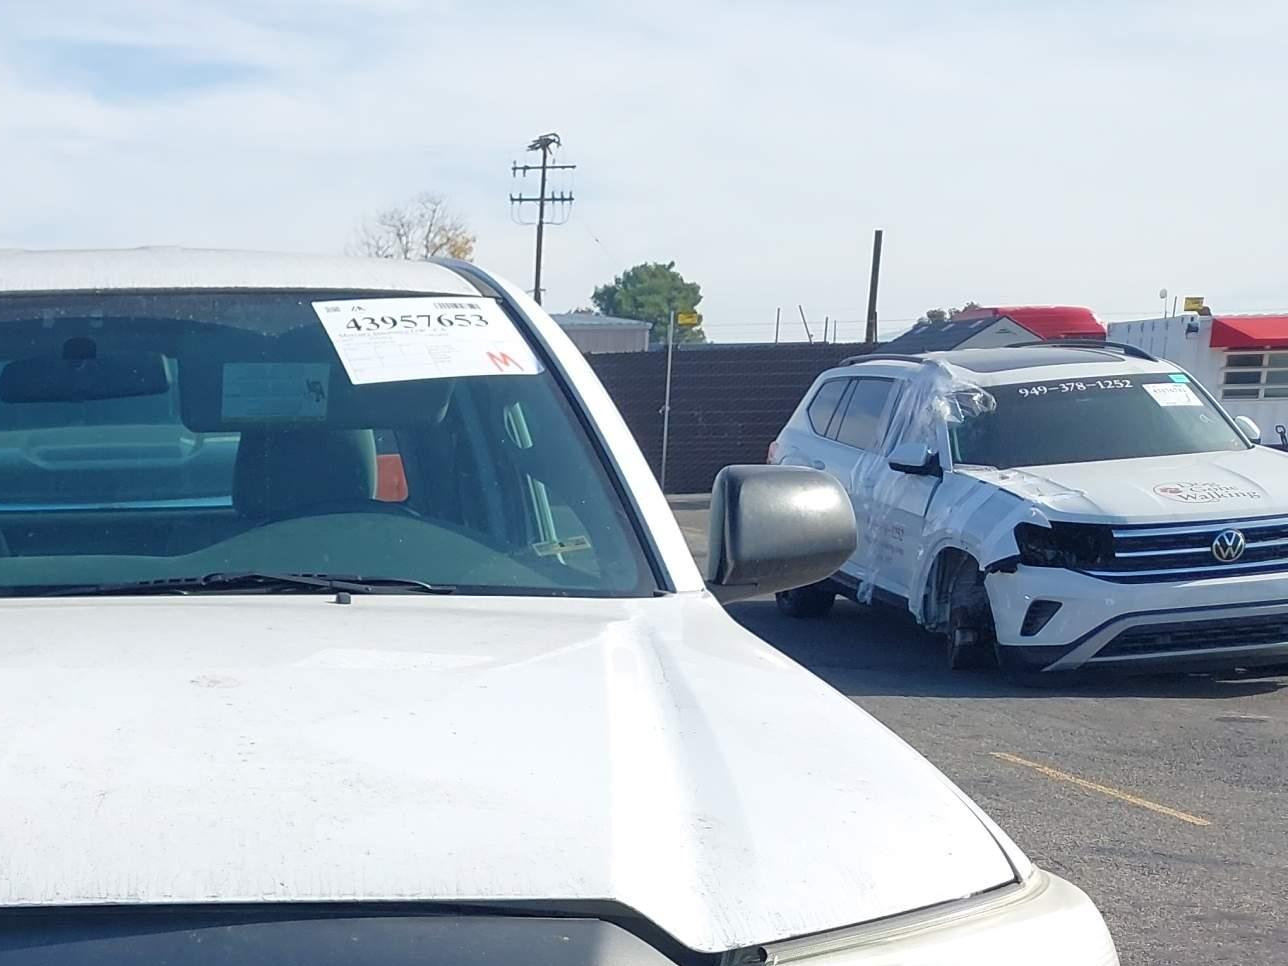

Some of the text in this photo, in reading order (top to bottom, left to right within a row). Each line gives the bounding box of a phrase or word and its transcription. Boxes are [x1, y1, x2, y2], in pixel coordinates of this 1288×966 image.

[345, 314, 489, 331] 43957653
[486, 351, 524, 373] M
[1018, 379, 1134, 398] 949-378-1252
[1176, 491, 1261, 501] Walking
